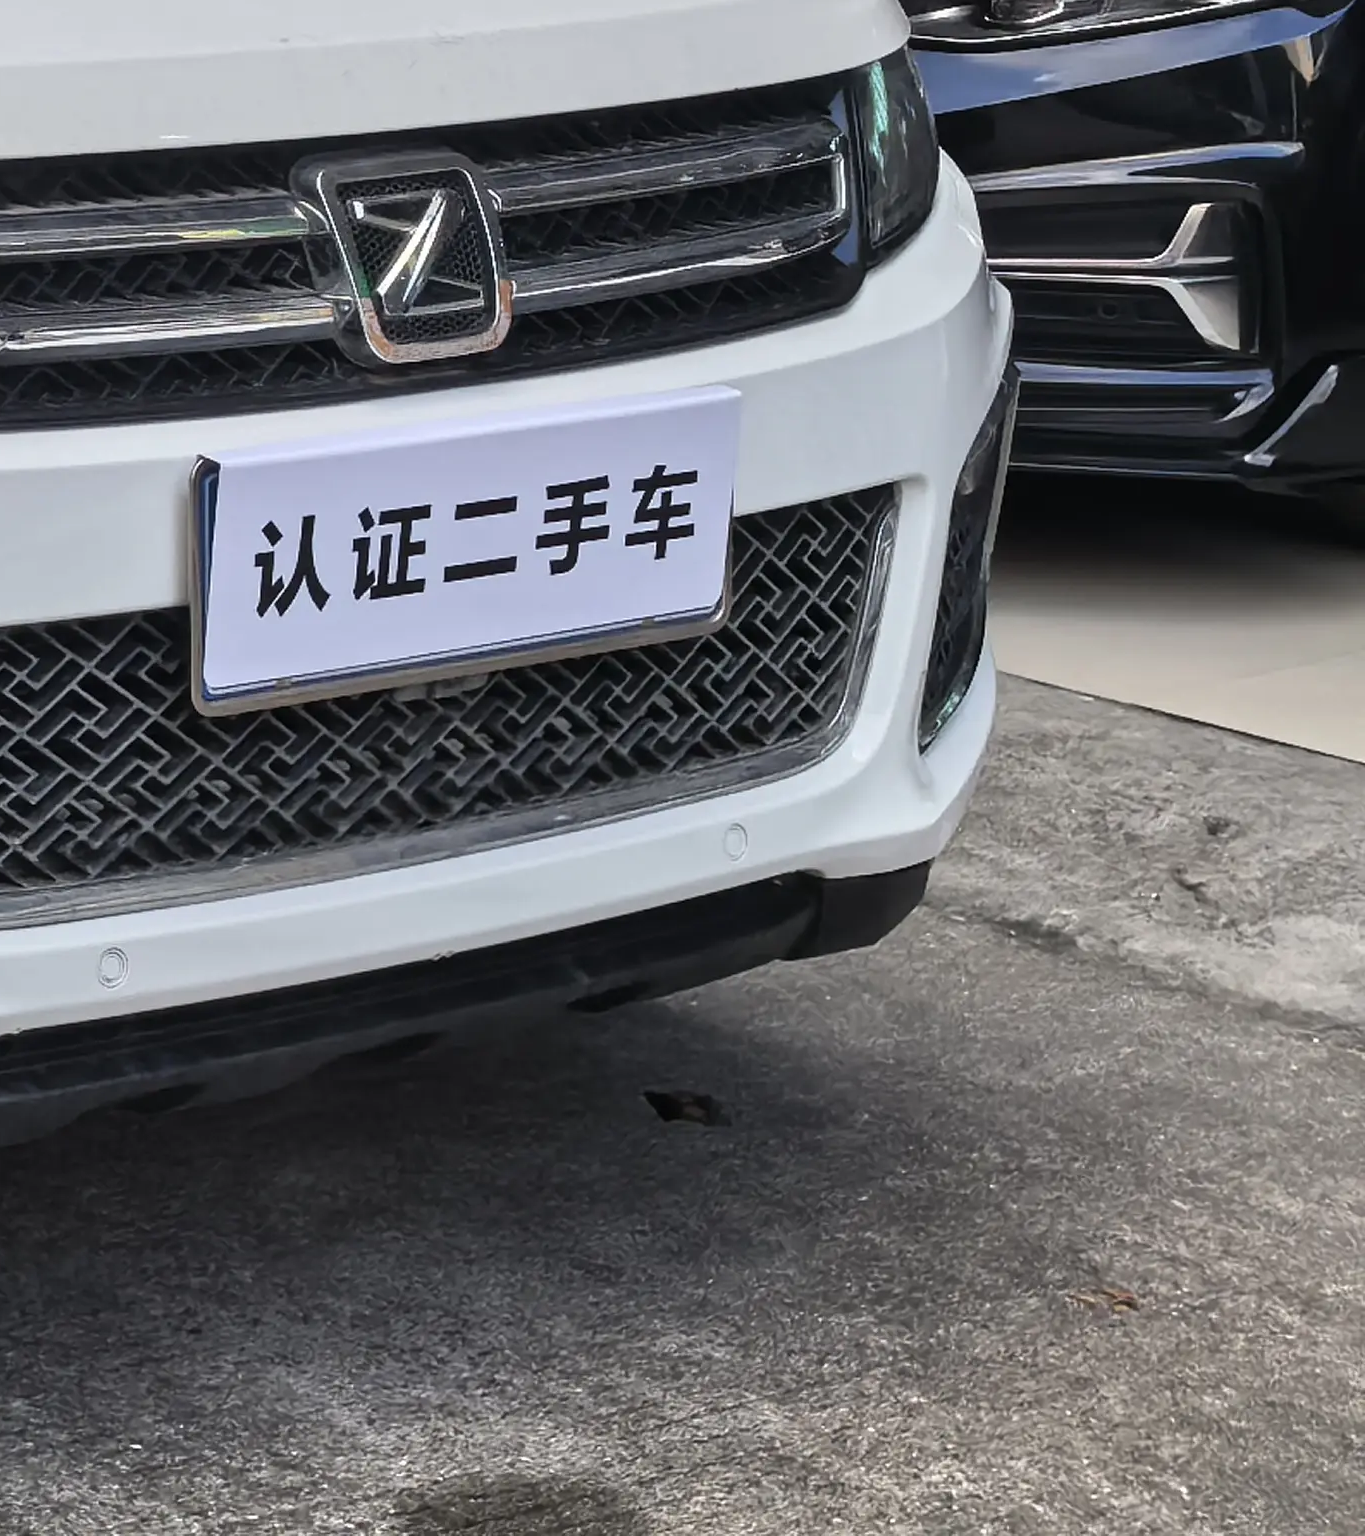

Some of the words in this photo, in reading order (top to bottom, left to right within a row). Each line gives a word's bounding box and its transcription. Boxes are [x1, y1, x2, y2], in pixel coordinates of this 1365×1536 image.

[253, 464, 699, 618] 认证二手车
